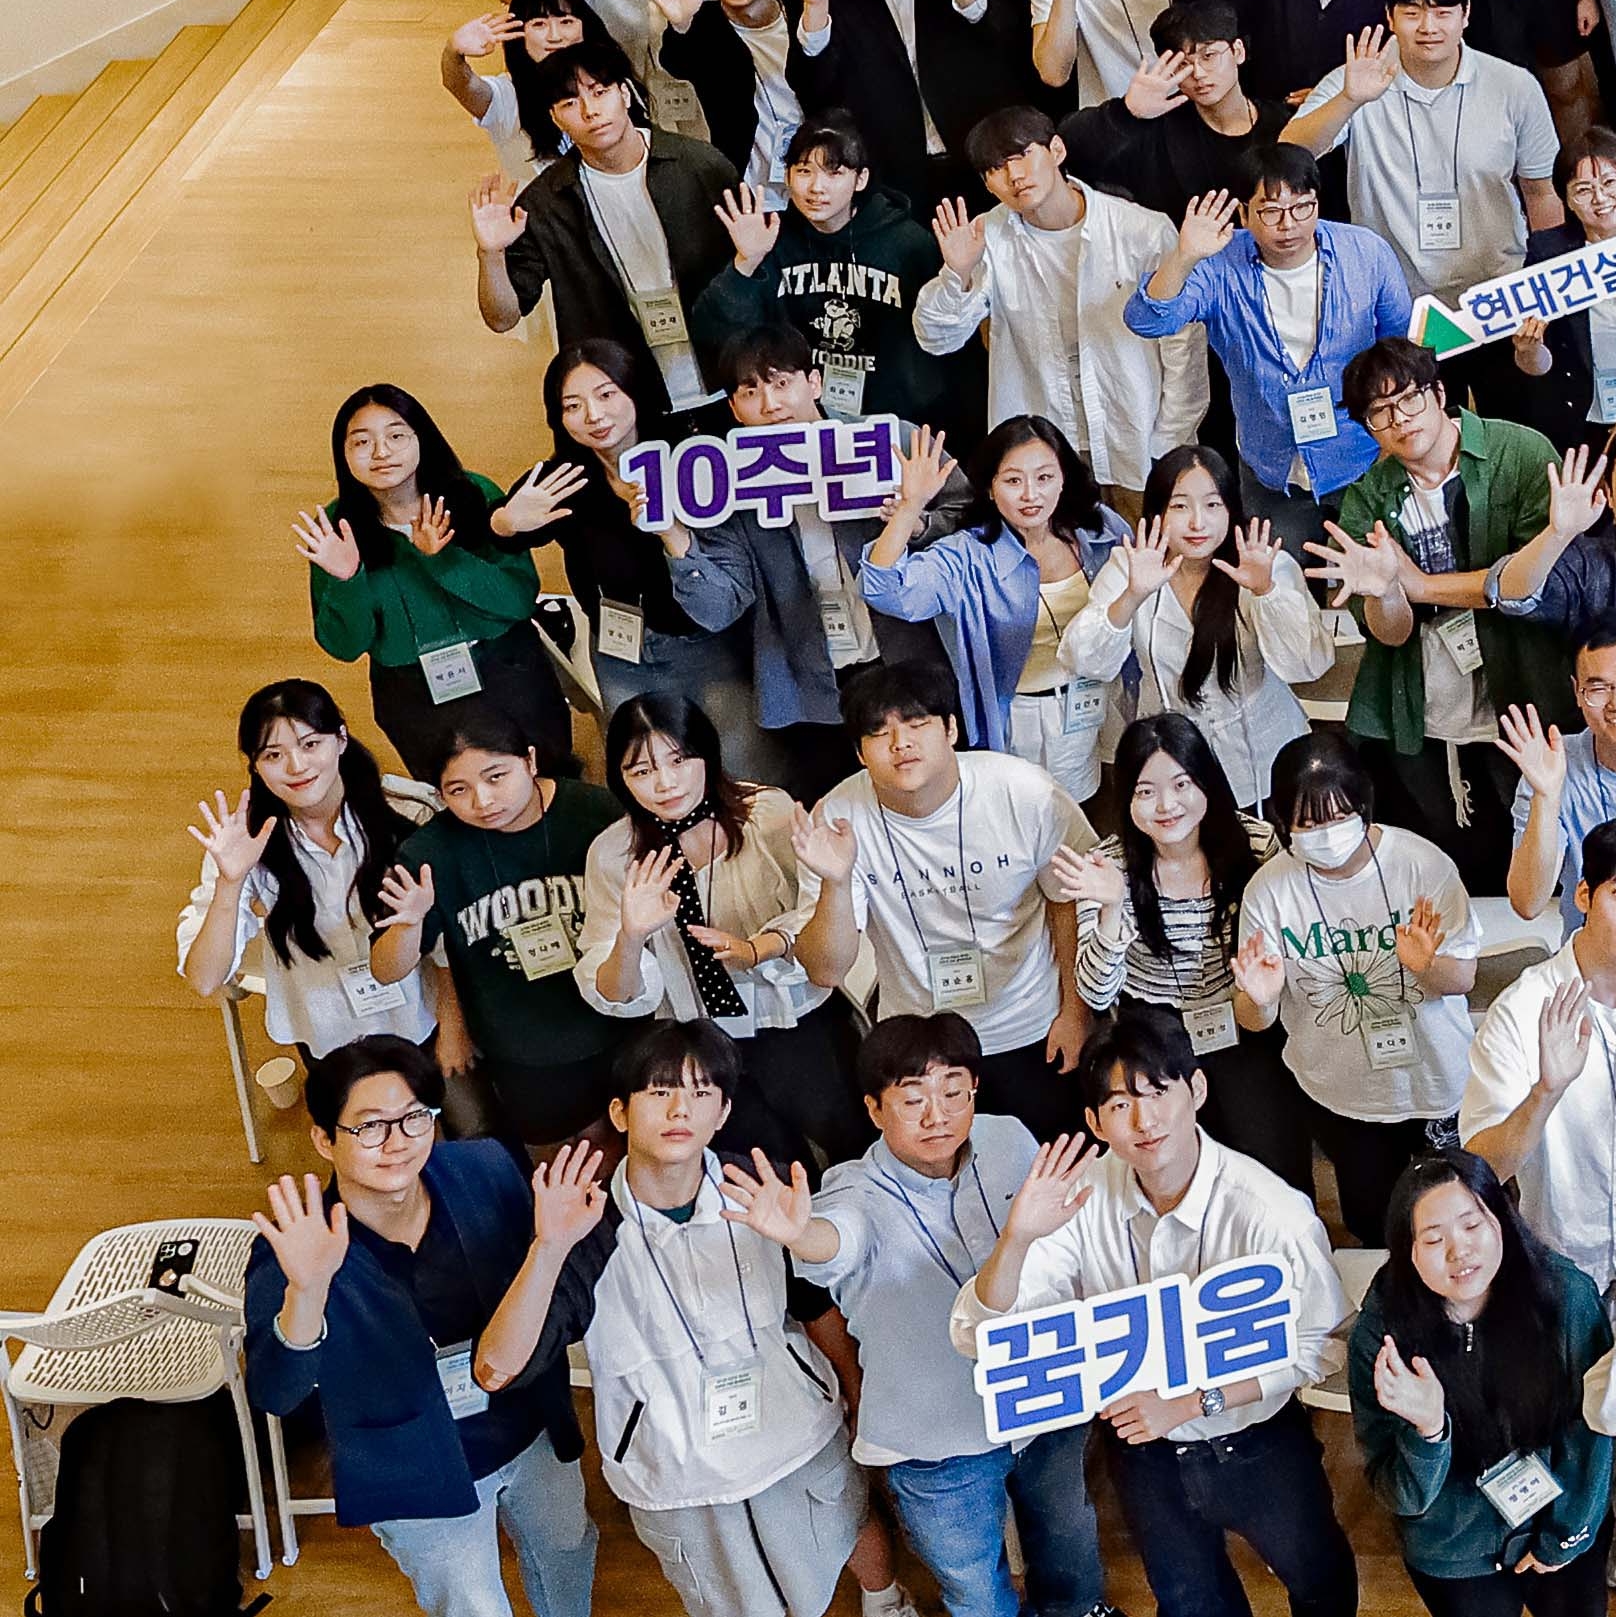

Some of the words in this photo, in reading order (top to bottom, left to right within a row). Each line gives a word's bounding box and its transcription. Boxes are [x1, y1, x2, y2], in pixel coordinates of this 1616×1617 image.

[777, 263, 902, 308] ATLANTA
[627, 419, 899, 524] 10주년
[867, 854, 1010, 885] SANNOH
[457, 875, 585, 947] WOOD
[1281, 908, 1415, 960] Mard
[986, 1264, 1291, 1433] 꿈키움
